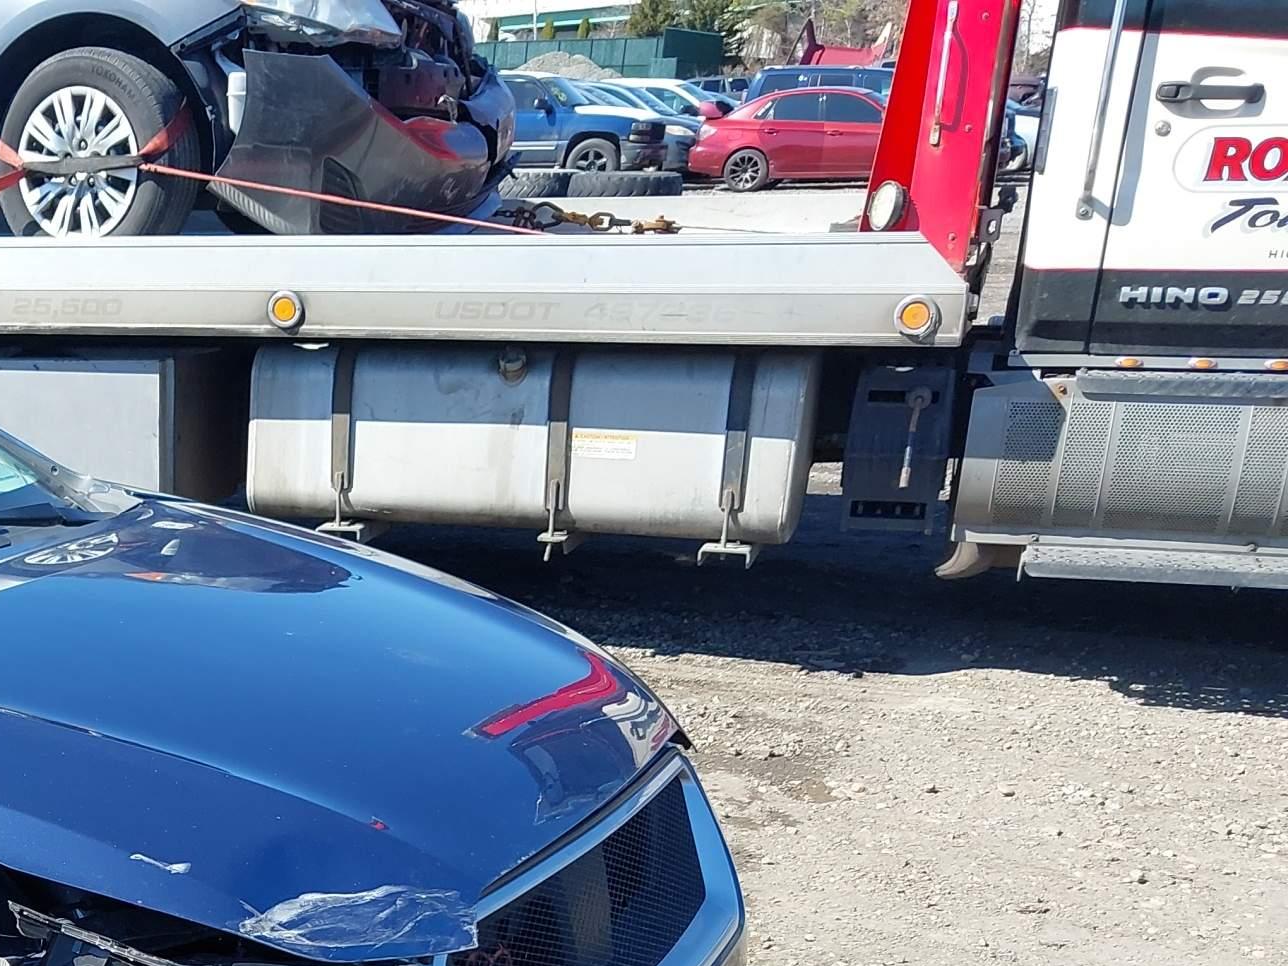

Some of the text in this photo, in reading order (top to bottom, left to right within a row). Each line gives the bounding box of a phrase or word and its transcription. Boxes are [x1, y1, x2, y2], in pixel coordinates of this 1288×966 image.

[91, 65, 137, 99] YOKOHAM
[1119, 286, 1229, 305] HINO
[12, 298, 123, 317] 25,500
[434, 301, 560, 321] USDOT
